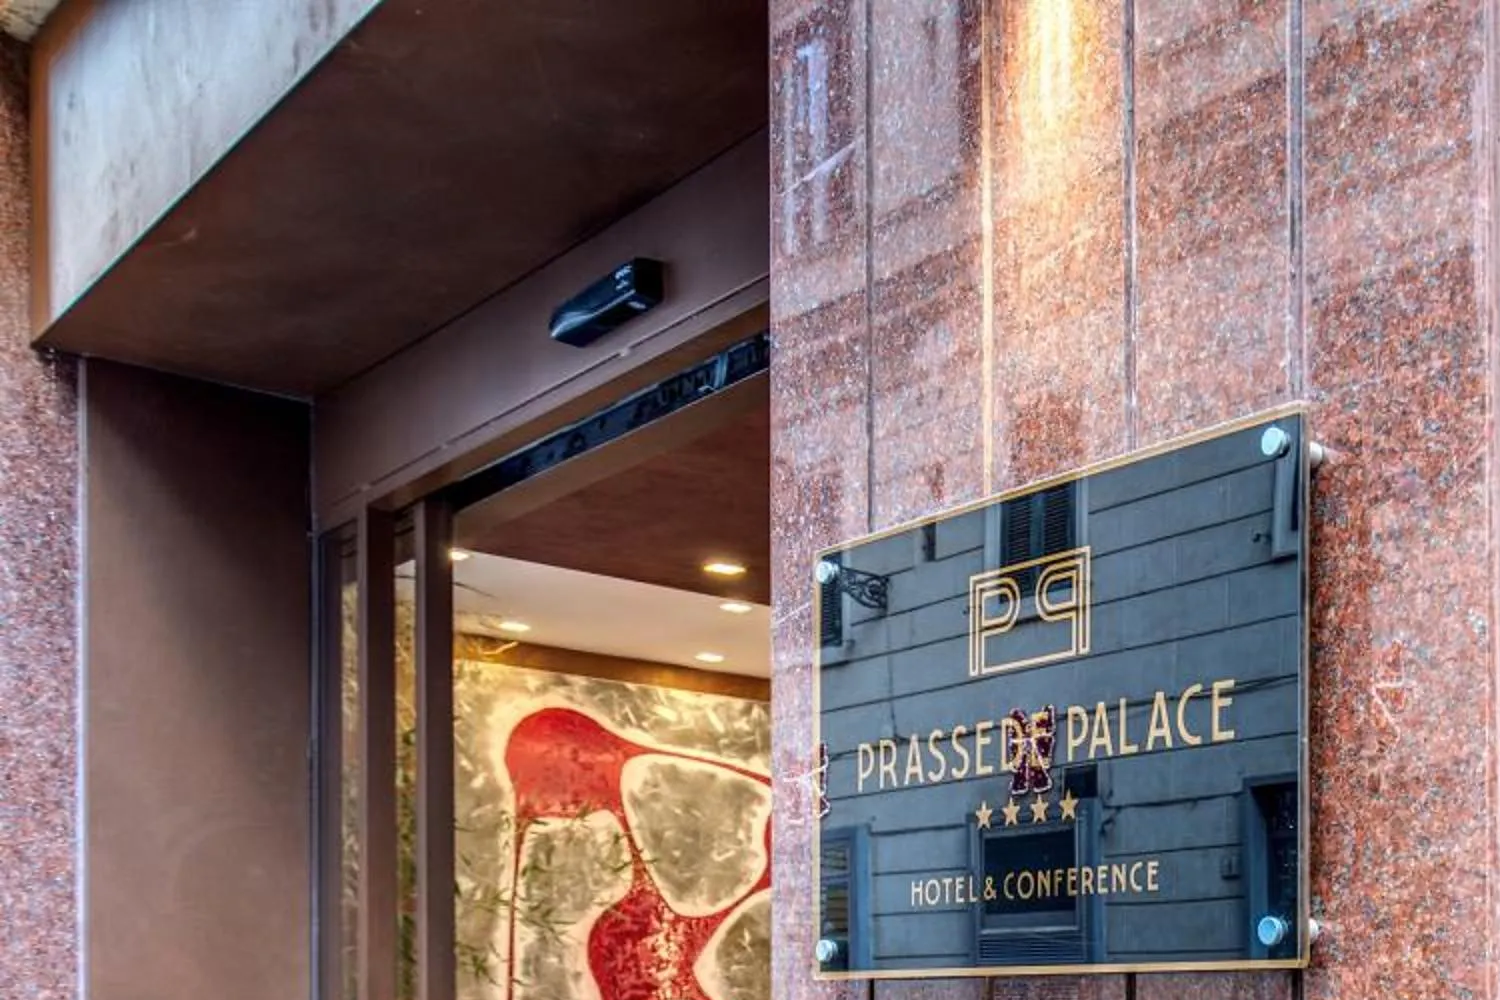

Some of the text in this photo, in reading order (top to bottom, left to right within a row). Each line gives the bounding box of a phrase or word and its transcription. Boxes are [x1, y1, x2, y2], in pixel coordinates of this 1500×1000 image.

[1067, 679, 1235, 762] PALACE
[911, 861, 1160, 906] HOTEL & CONFERENCE
